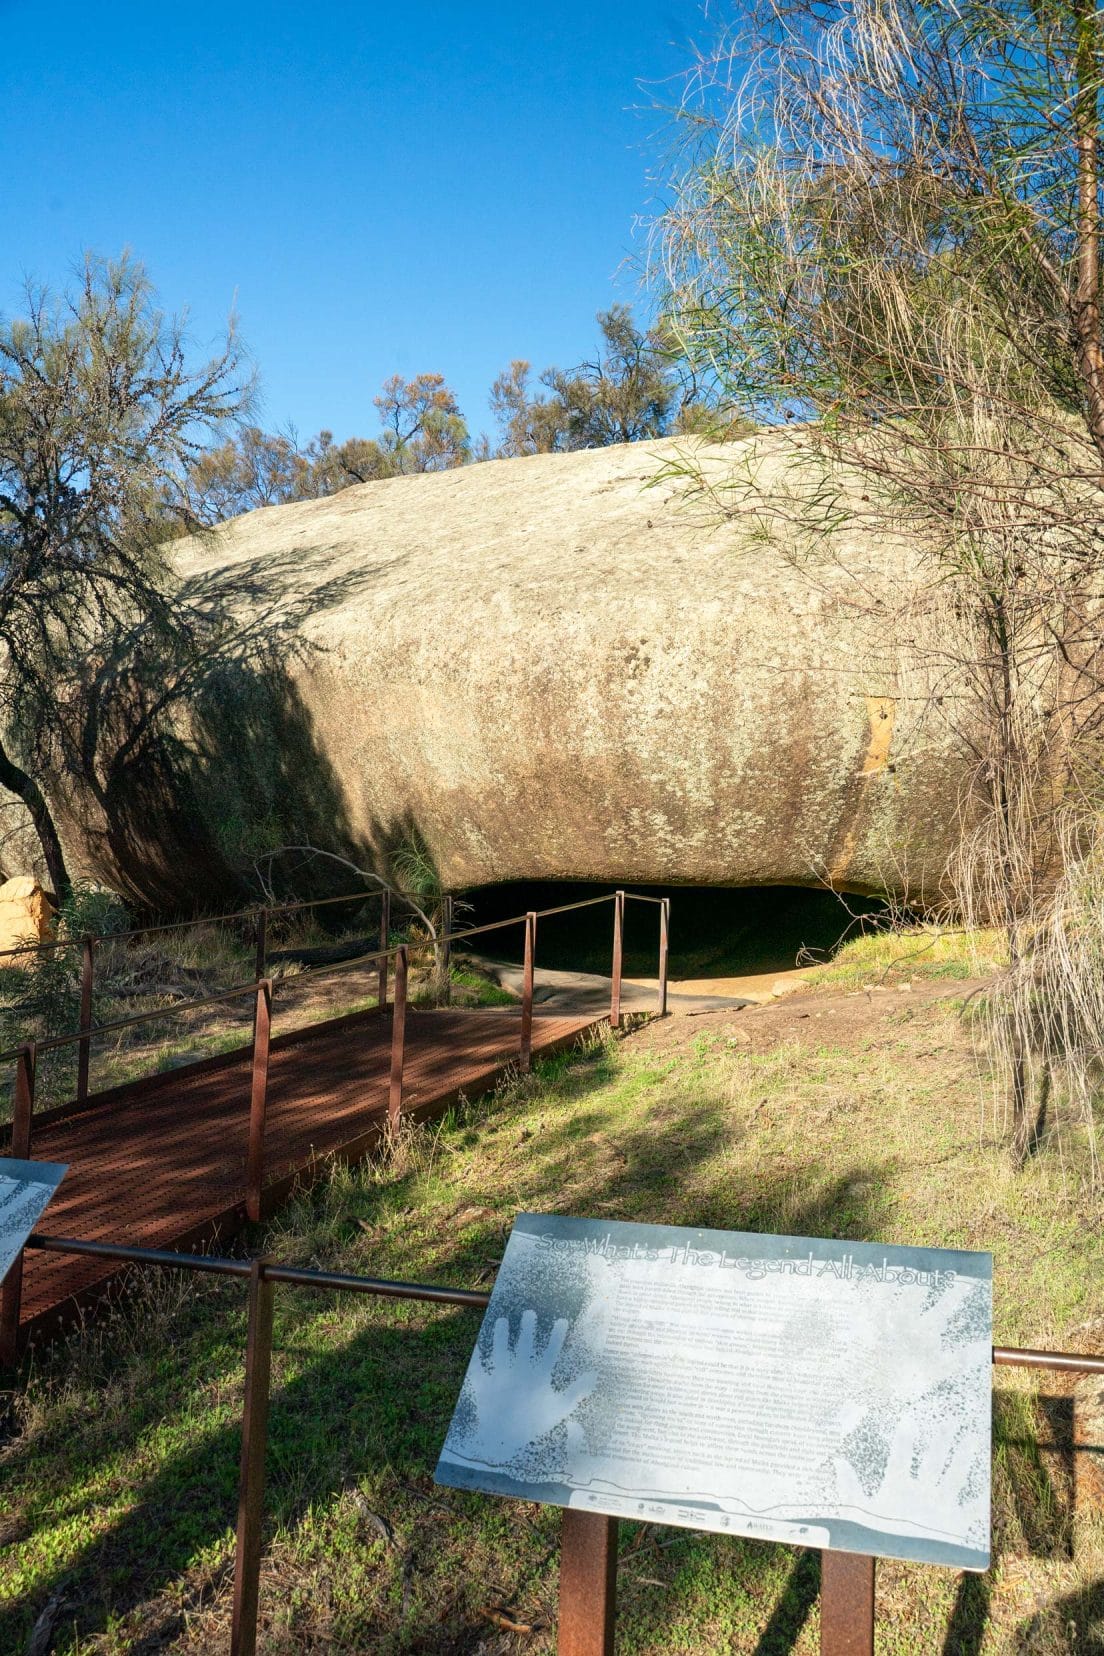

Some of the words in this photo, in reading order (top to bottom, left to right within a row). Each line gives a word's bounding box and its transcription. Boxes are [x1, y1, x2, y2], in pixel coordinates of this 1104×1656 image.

[584, 1233, 659, 1261] What's
[667, 1241, 714, 1266] The
[719, 1250, 813, 1280] Legend
[816, 1254, 853, 1280] All
[858, 1258, 958, 1289] About?
